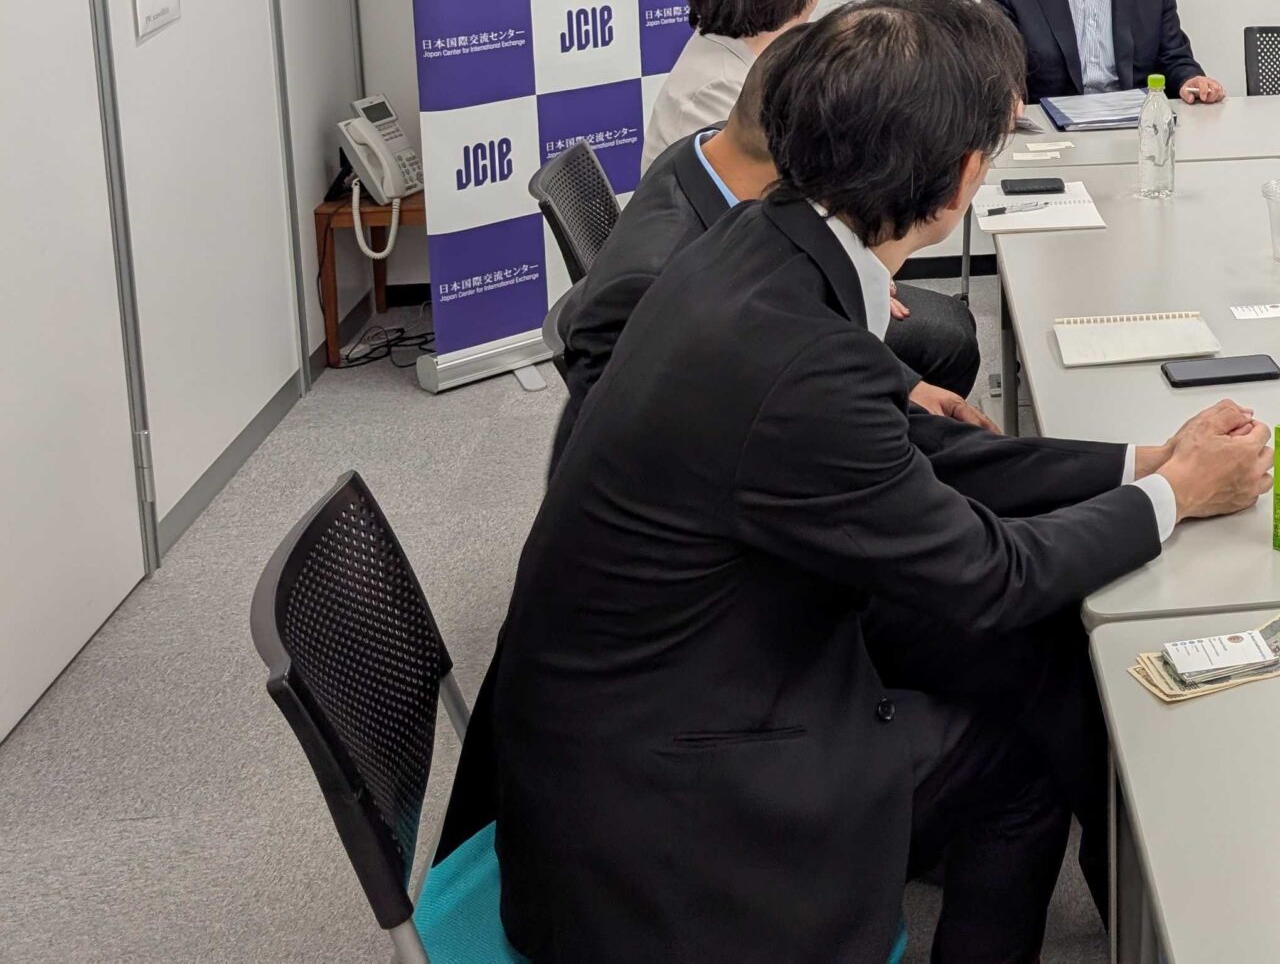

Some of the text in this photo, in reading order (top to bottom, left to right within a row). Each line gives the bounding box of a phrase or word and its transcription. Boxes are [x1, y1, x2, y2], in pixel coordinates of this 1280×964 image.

[422, 29, 525, 49] 日本国際交流センター
[439, 264, 539, 294] 日本国際交流センター
